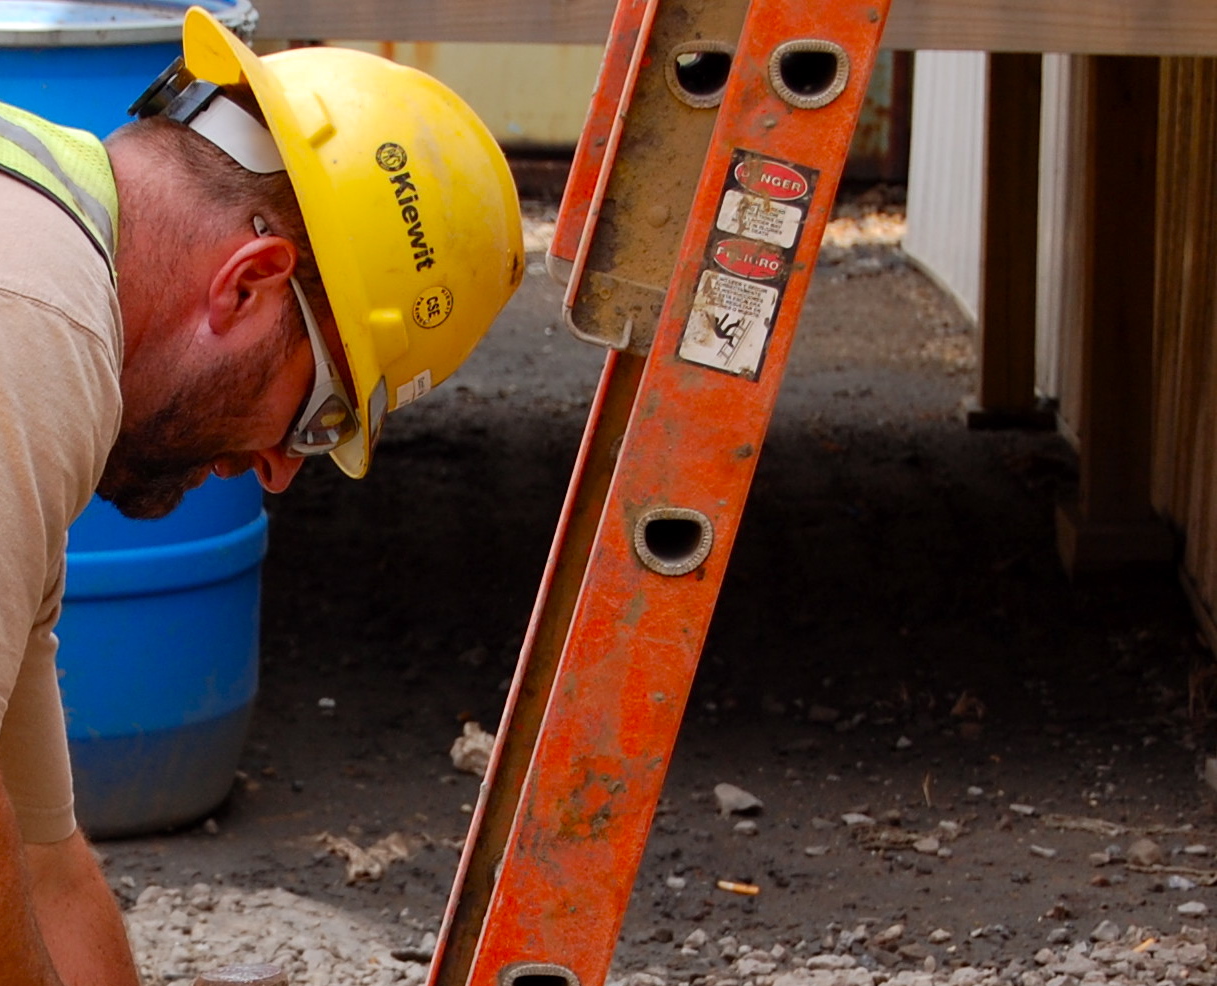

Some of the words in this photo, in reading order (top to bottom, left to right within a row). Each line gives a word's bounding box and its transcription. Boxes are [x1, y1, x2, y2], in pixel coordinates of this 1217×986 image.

[740, 168, 802, 193] DNGER
[389, 171, 436, 273] Kiewit
[426, 295, 441, 318] CSE
